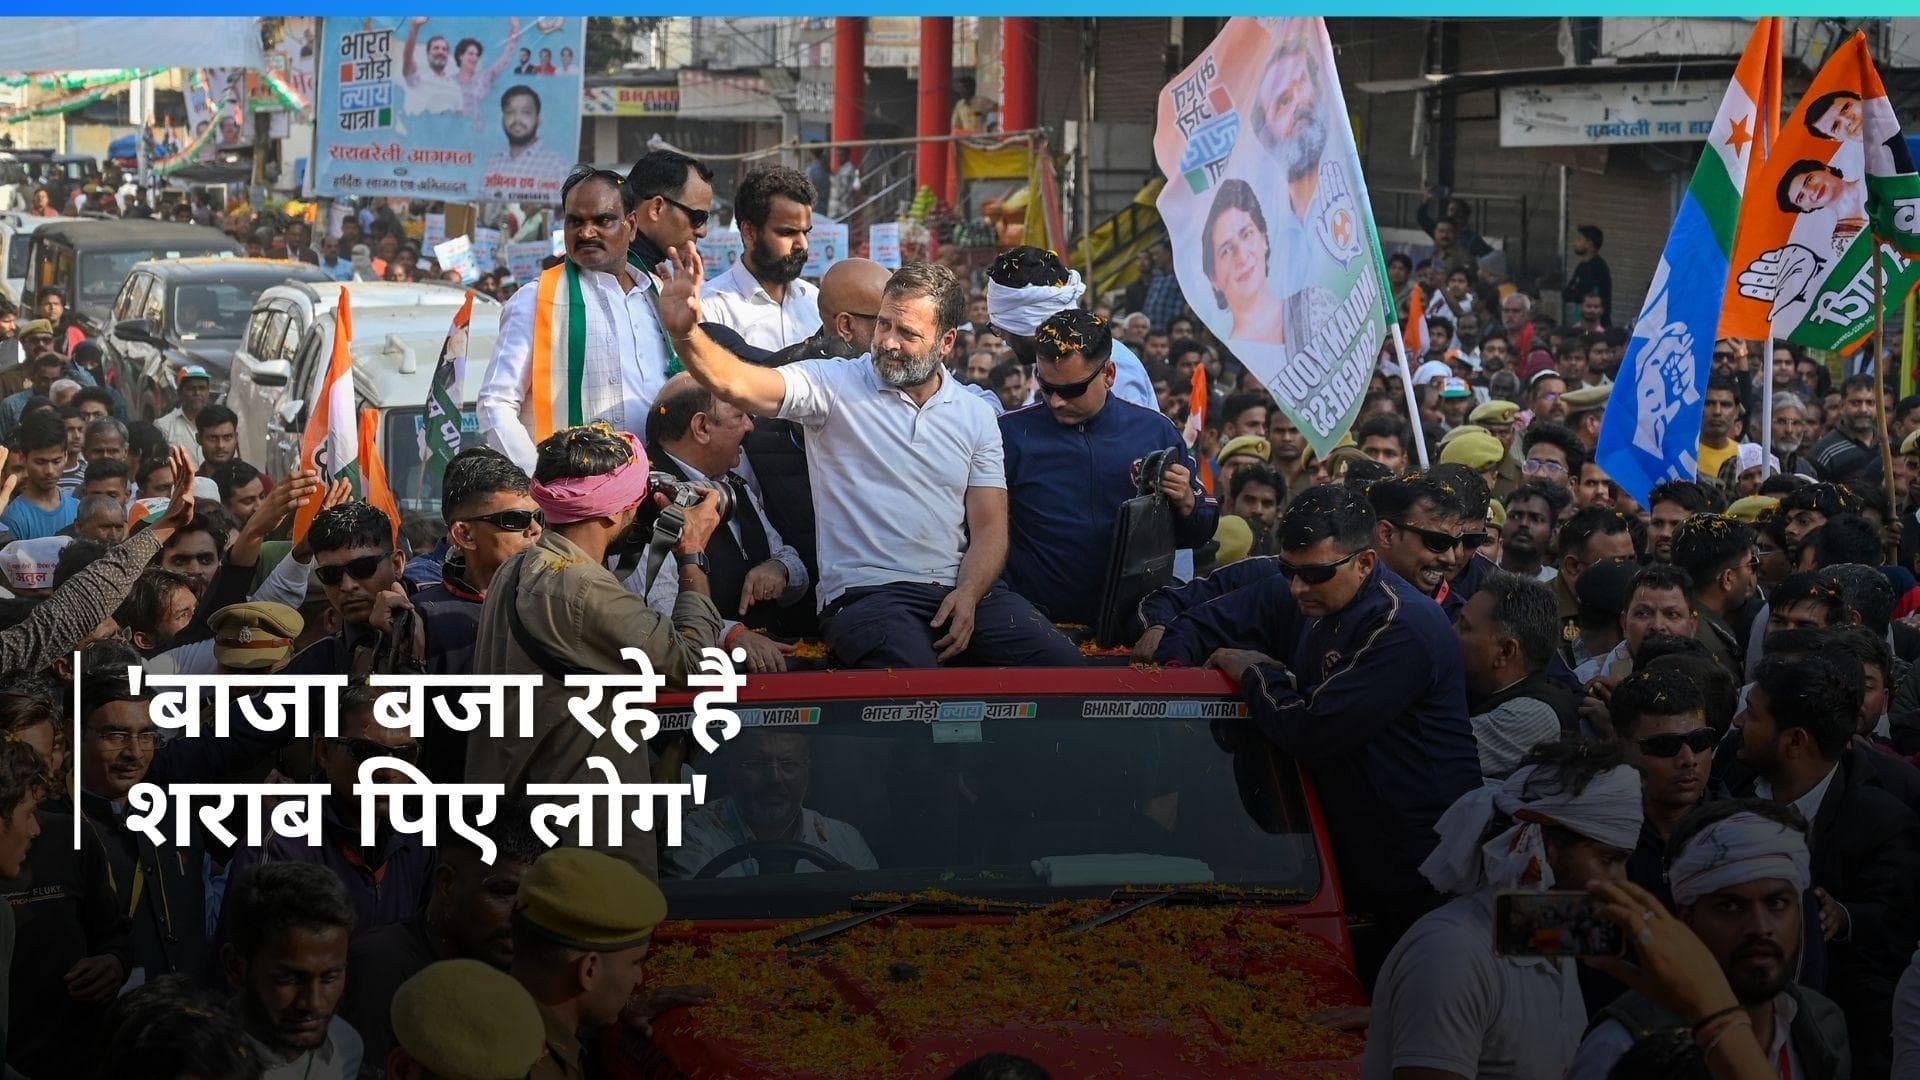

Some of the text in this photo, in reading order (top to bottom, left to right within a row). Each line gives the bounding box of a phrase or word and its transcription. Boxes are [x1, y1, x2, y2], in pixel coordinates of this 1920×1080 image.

[341, 30, 393, 60] भारत
[355, 54, 393, 83] जोड़ो
[341, 82, 392, 110] न्याय
[339, 110, 376, 131] यात्रा
[329, 143, 473, 165] रायबरेली आगमन
[15, 572, 47, 586] अतुल
[763, 709, 799, 725] YATRA
[862, 702, 1018, 722] भारत जोड़ो न्याय यात्रा
[1083, 702, 1236, 717] BHARAT JODO NYAY YATRA
